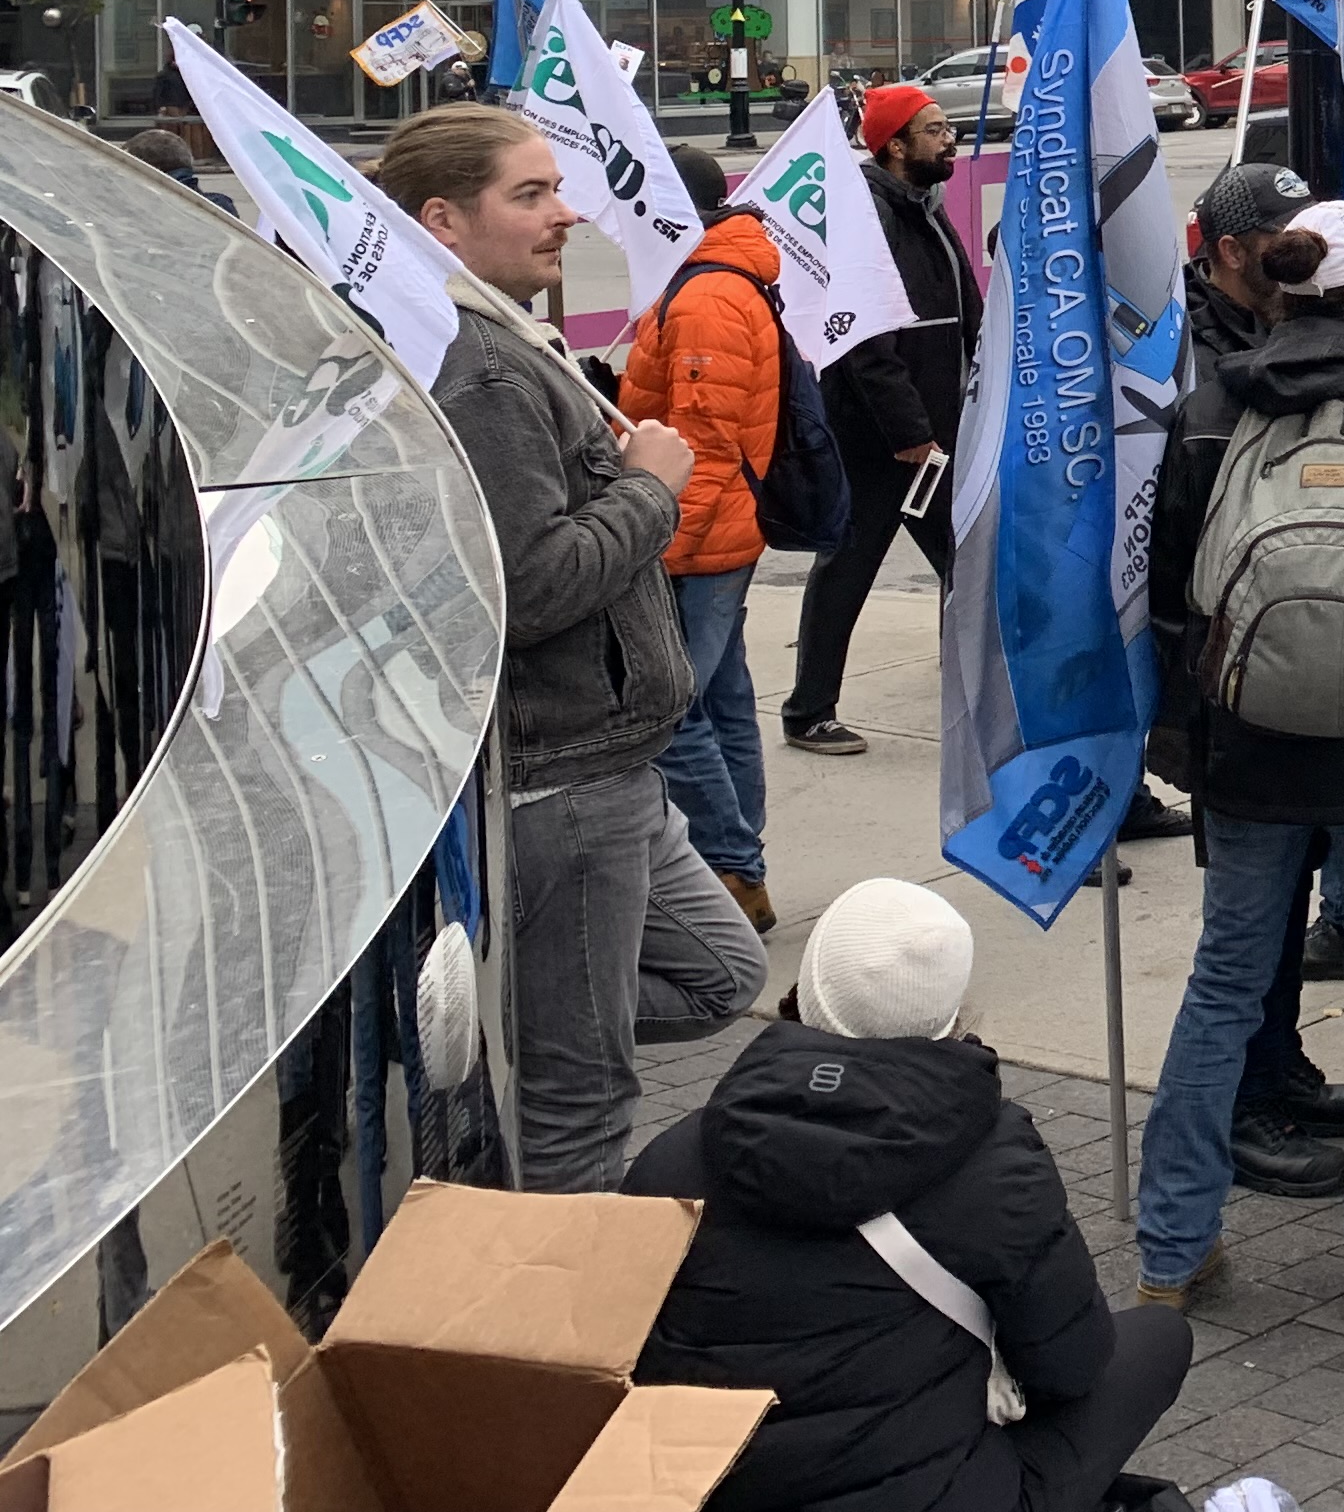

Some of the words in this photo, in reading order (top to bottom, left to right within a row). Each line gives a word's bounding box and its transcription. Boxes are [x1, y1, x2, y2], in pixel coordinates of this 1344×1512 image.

[538, 117, 558, 129] DES
[1031, 48, 1080, 238] Syndicat
[653, 218, 681, 244] CSN
[784, 232, 799, 248] DES
[781, 243, 812, 272] SERVICES
[1043, 248, 1105, 502] CA.OM.SC.
[1020, 393, 1052, 464] 1983
